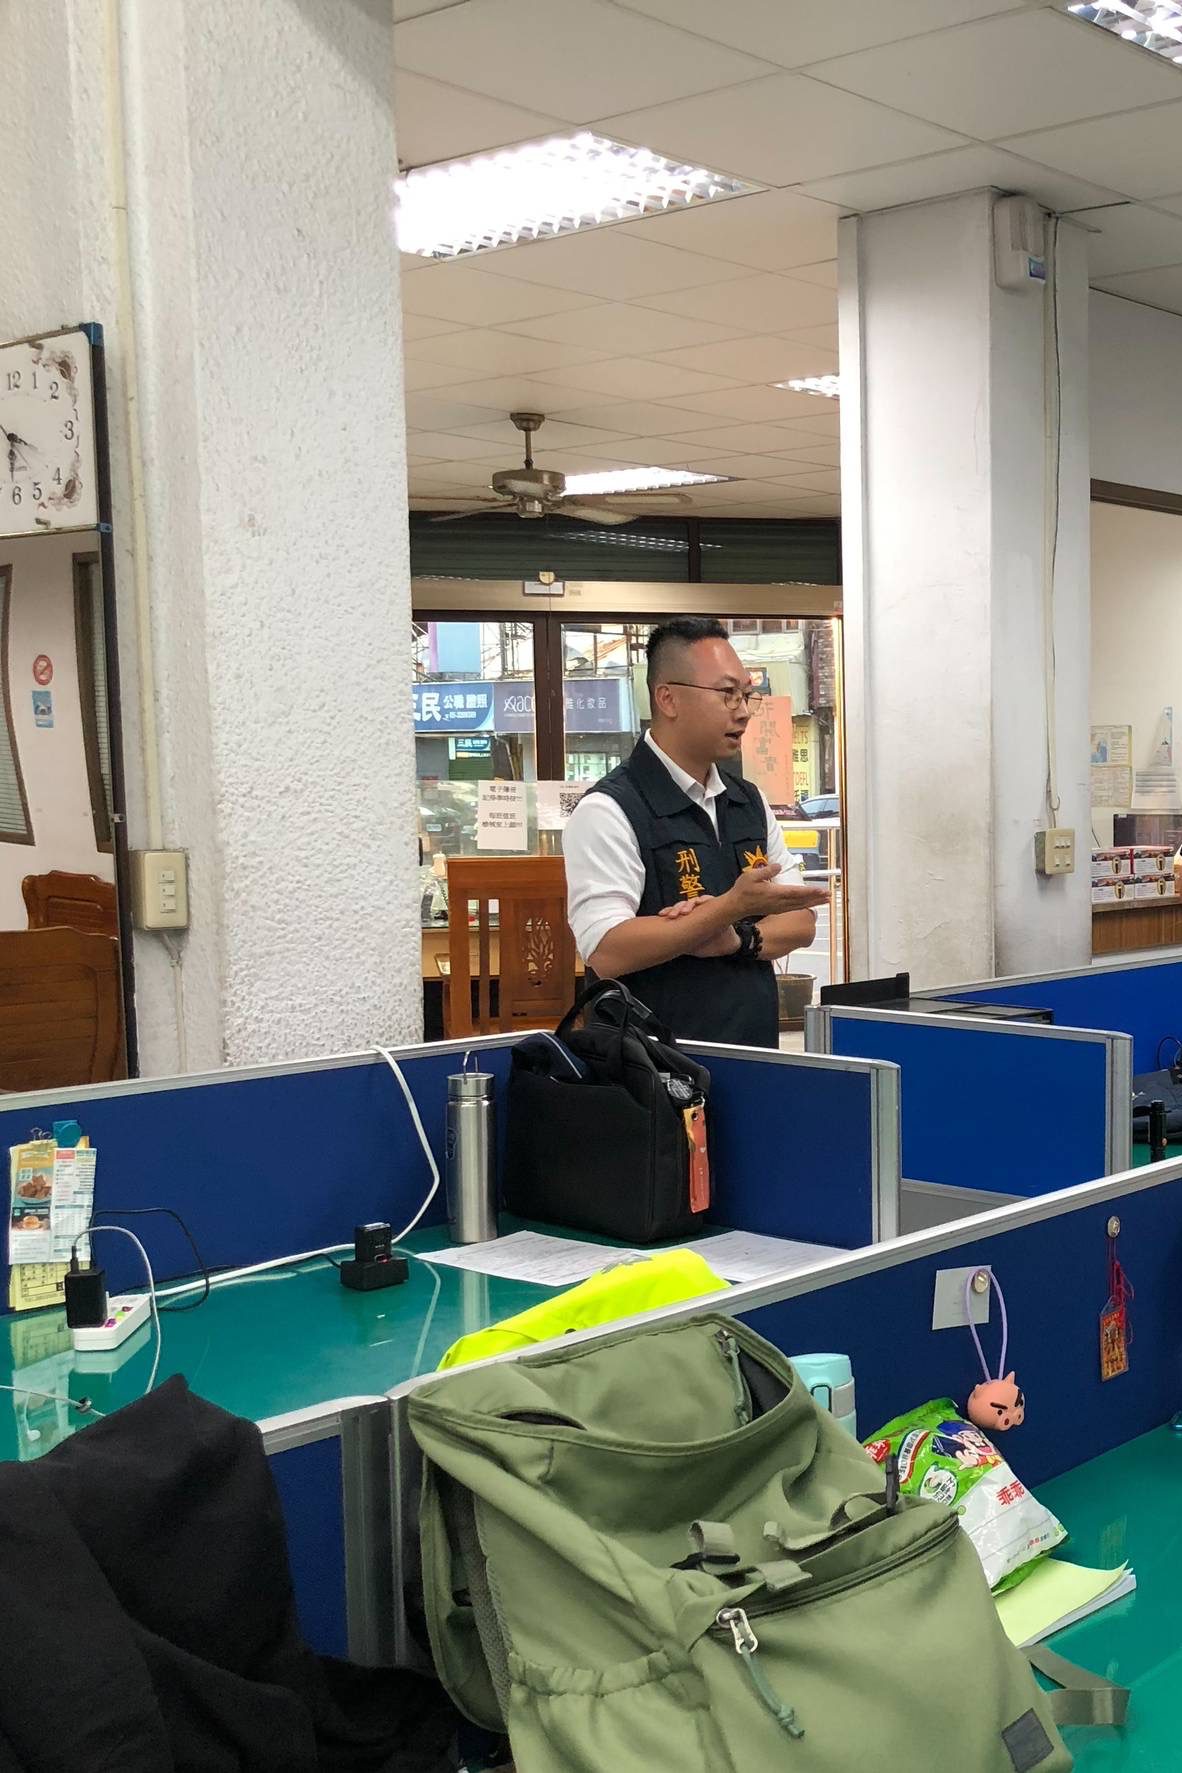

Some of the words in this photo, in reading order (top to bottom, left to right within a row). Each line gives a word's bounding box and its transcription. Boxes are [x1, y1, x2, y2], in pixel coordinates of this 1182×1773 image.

[7, 370, 21, 391] 12
[32, 371, 38, 389] 1
[50, 381, 59, 400] 2
[63, 420, 74, 440] 3
[53, 467, 62, 485] 4
[12, 486, 22, 505] 6
[32, 482, 42, 501] 5
[675, 847, 706, 899] 刑警
[996, 1479, 1026, 1506] 乖乖
